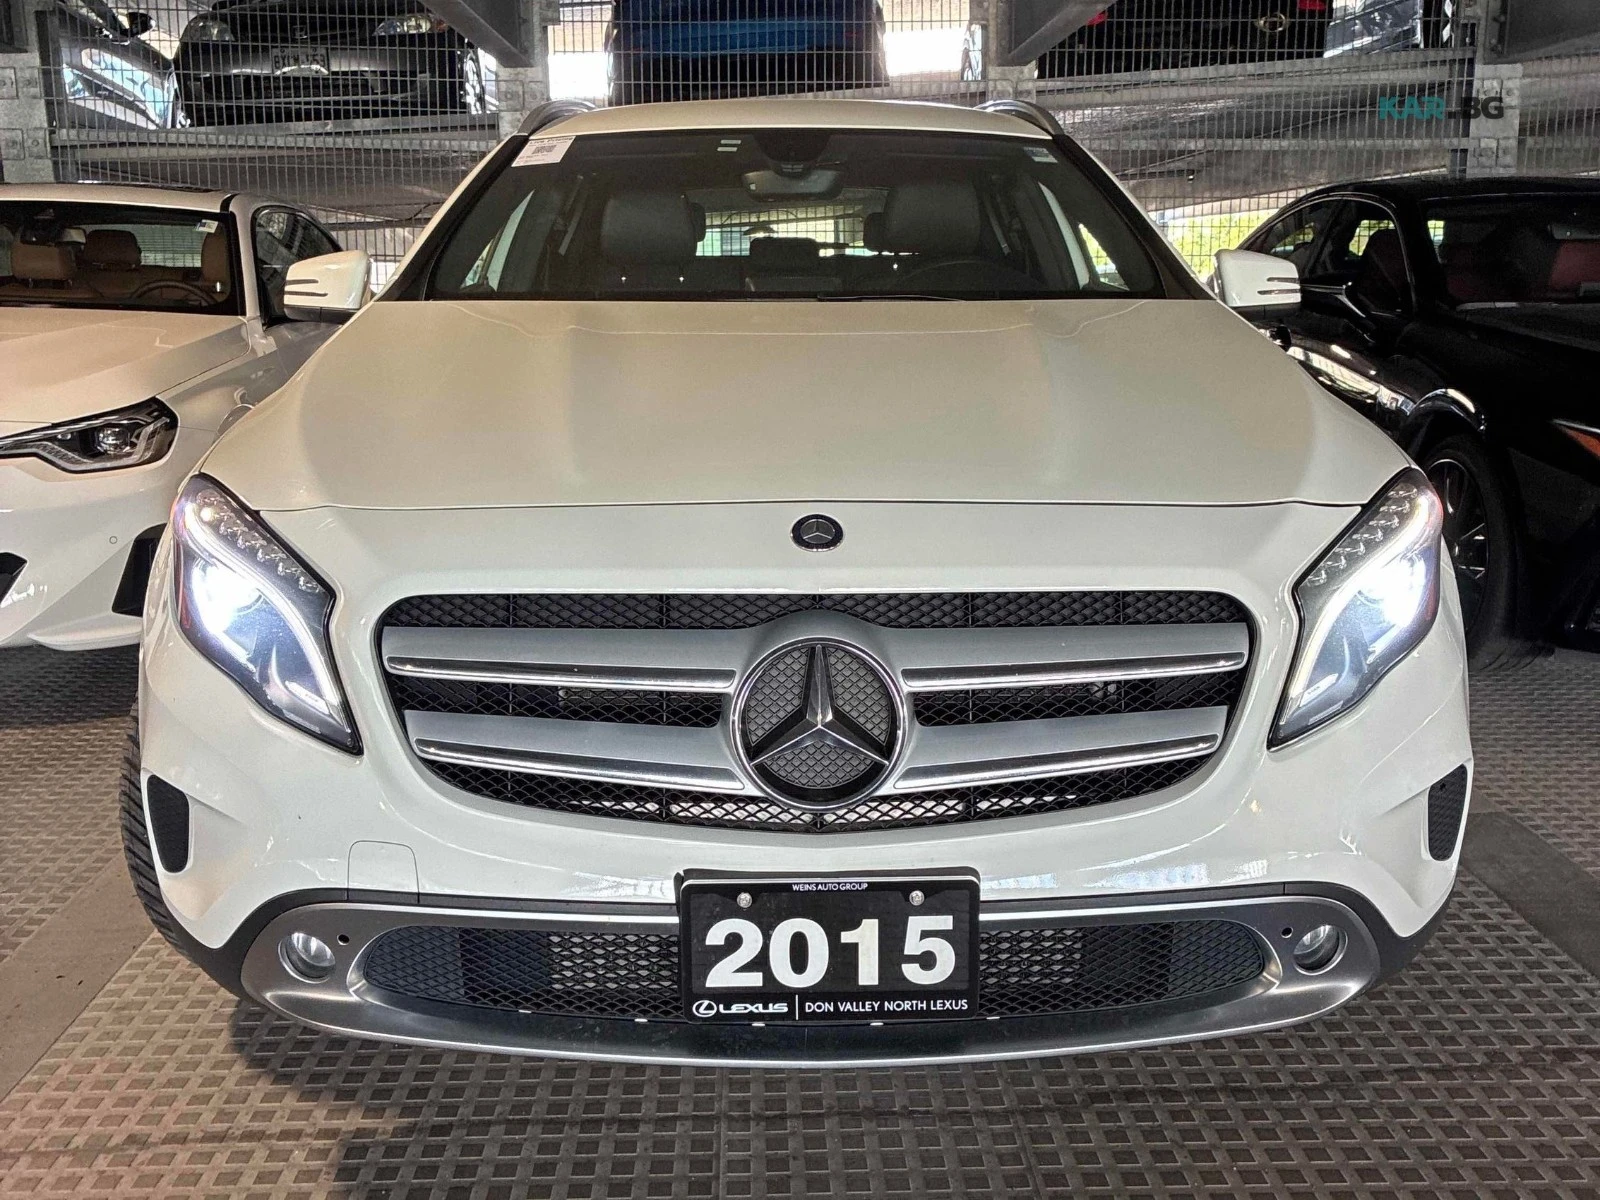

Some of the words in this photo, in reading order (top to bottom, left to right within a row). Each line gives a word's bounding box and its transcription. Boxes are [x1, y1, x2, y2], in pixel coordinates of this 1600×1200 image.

[792, 883, 816, 891] WEINS
[817, 883, 839, 891] AUTO
[839, 882, 868, 891] GROUP
[705, 915, 956, 988] 2015
[719, 1003, 789, 1014] LEXUS
[805, 1001, 834, 1013] DON
[838, 1001, 880, 1012] VALLEY
[884, 1000, 926, 1011] NORTH
[930, 999, 968, 1010] LEXUS
